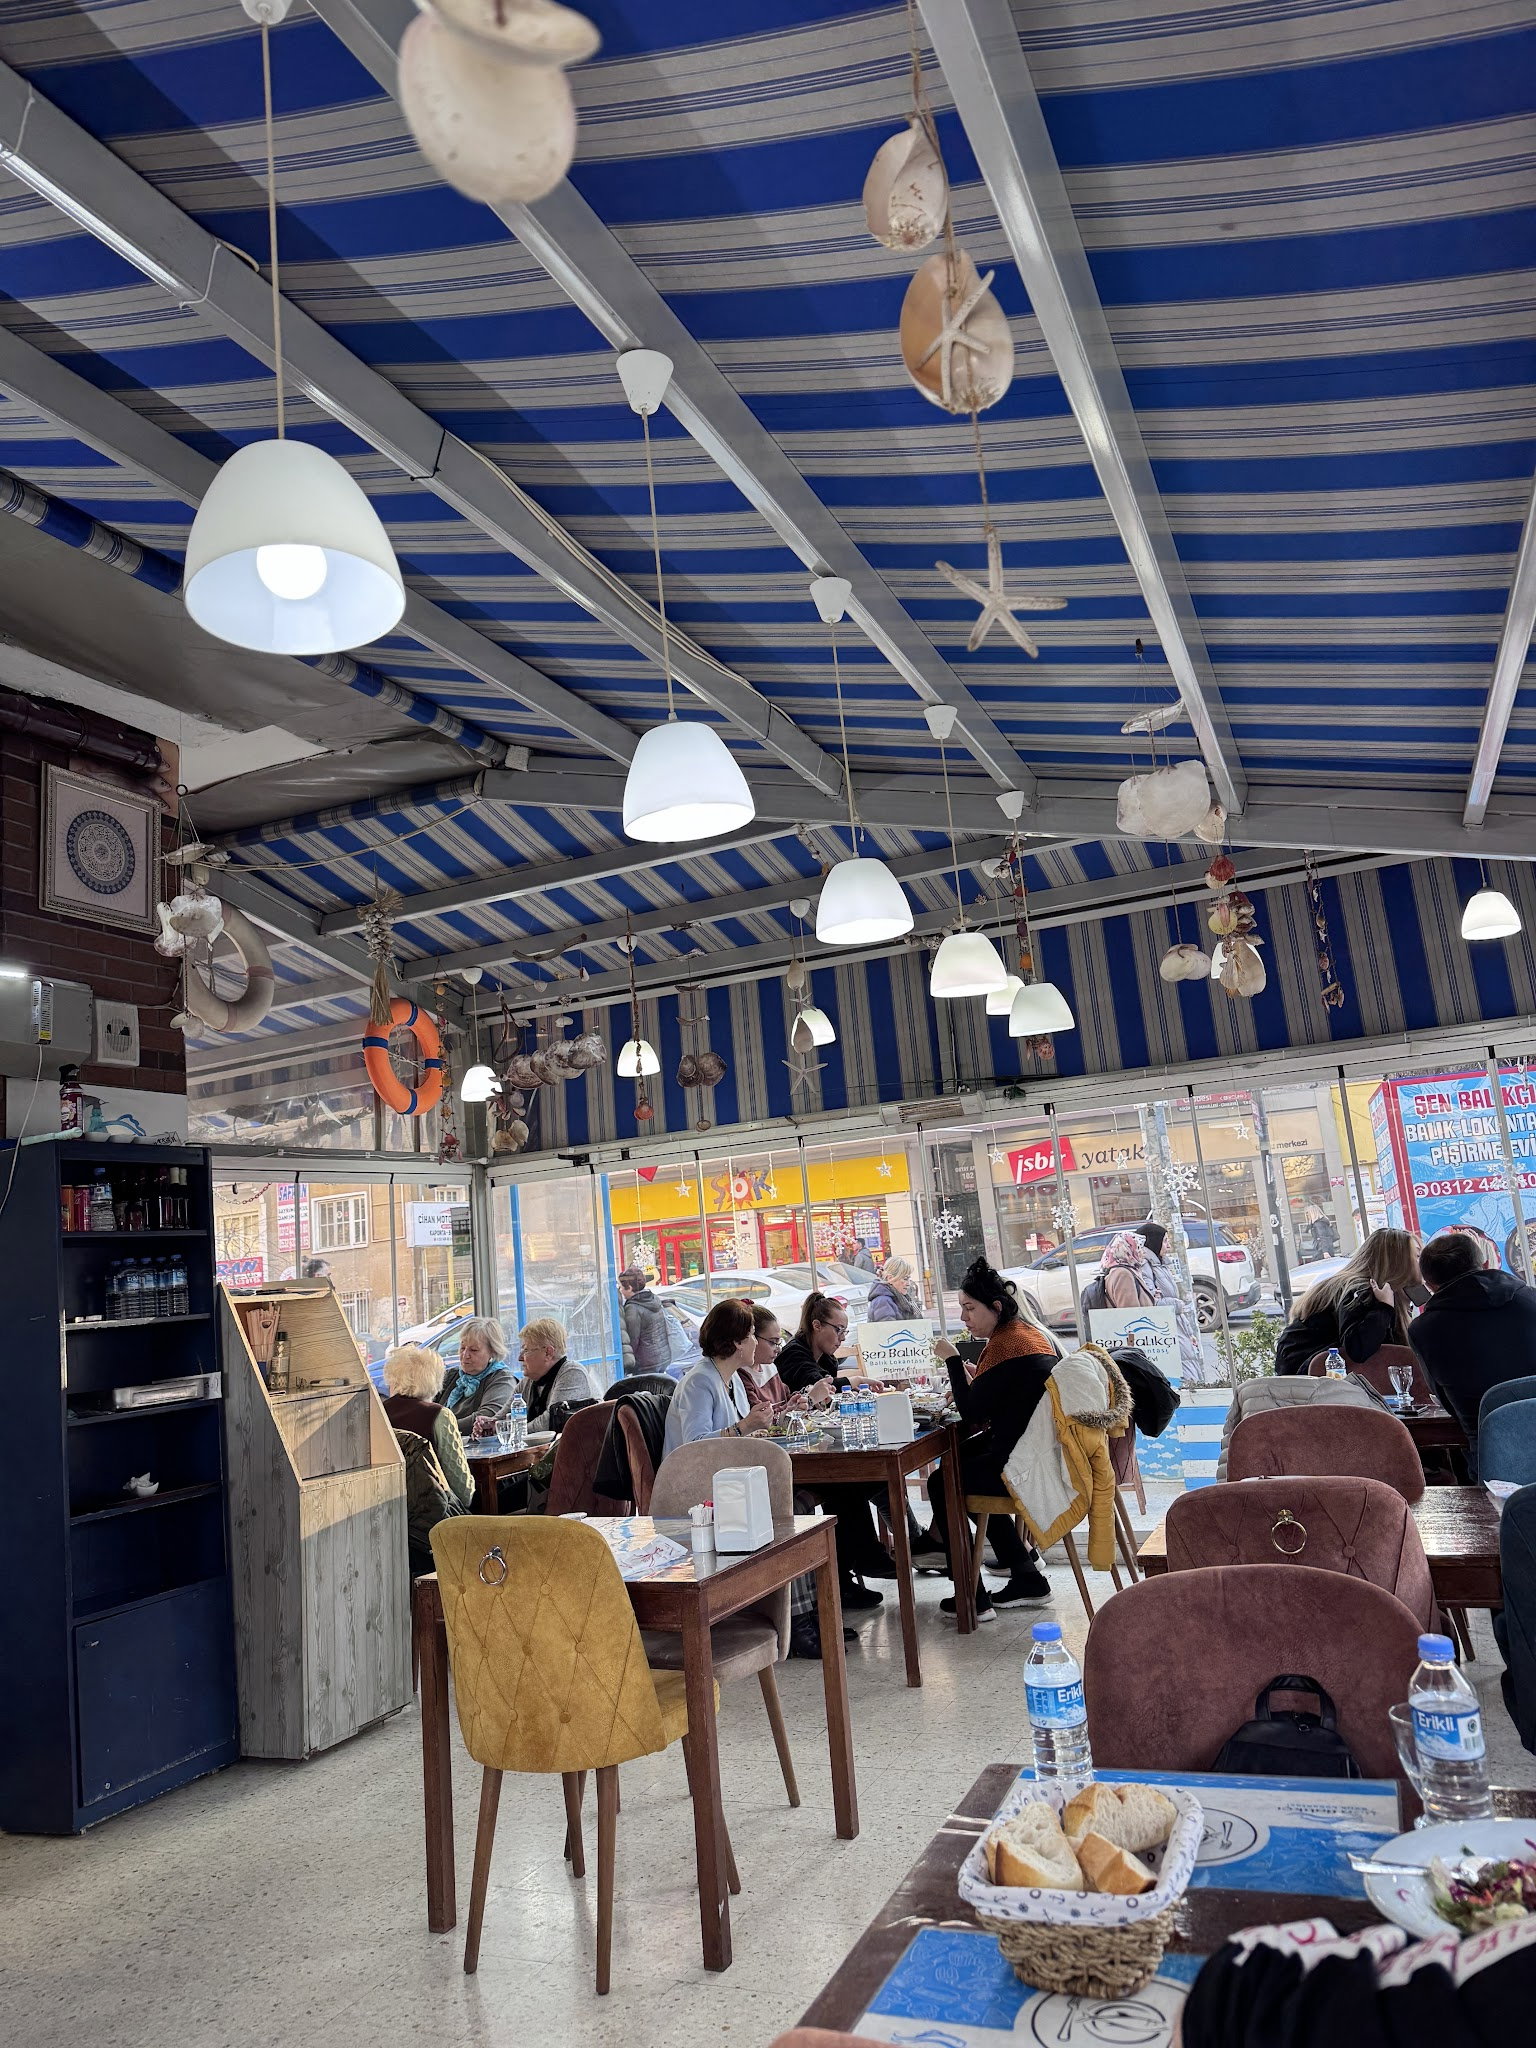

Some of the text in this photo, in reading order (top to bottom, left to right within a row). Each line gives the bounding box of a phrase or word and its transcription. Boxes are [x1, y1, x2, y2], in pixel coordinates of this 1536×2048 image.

[1414, 1092, 1452, 1118] ŞEN
[1458, 1084, 1536, 1110] BALKÇI
[1405, 1120, 1457, 1143] BALIK
[1276, 1139, 1308, 1149] merkezi
[1430, 1140, 1503, 1167] PİŞİRME
[1081, 1143, 1147, 1170] yatak
[962, 1172, 975, 1180] 102
[1430, 1179, 1475, 1196] 0312
[1126, 1335, 1176, 1348] alıkçı
[1417, 1711, 1457, 1732] Erikli
